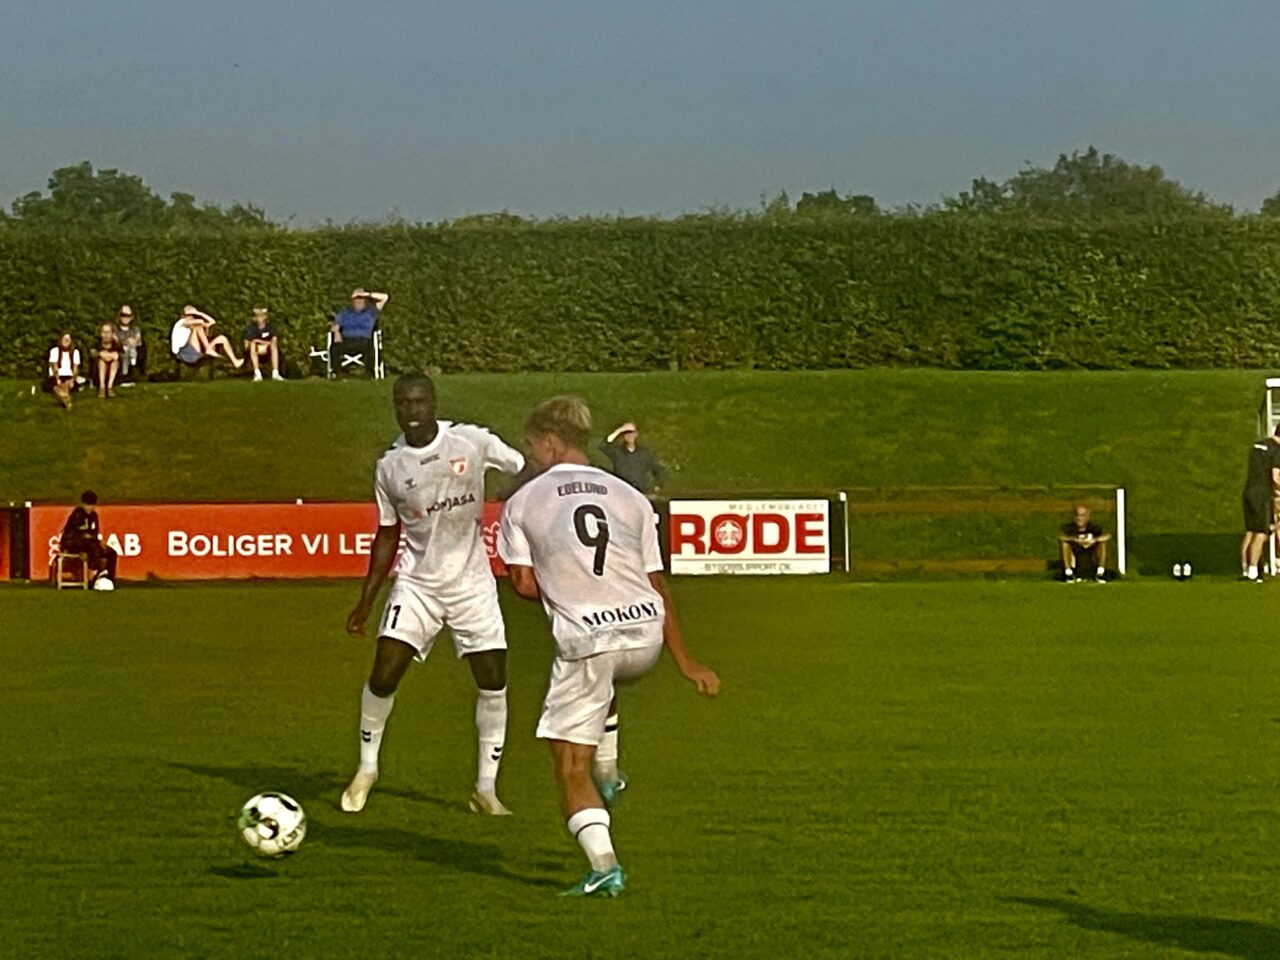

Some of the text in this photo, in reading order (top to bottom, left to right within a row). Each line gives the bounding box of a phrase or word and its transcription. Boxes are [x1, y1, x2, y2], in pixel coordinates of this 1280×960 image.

[168, 531, 293, 556] BOLIGER
[301, 534, 329, 555] VI
[573, 504, 610, 576] 9
[669, 513, 826, 555] RØDE
